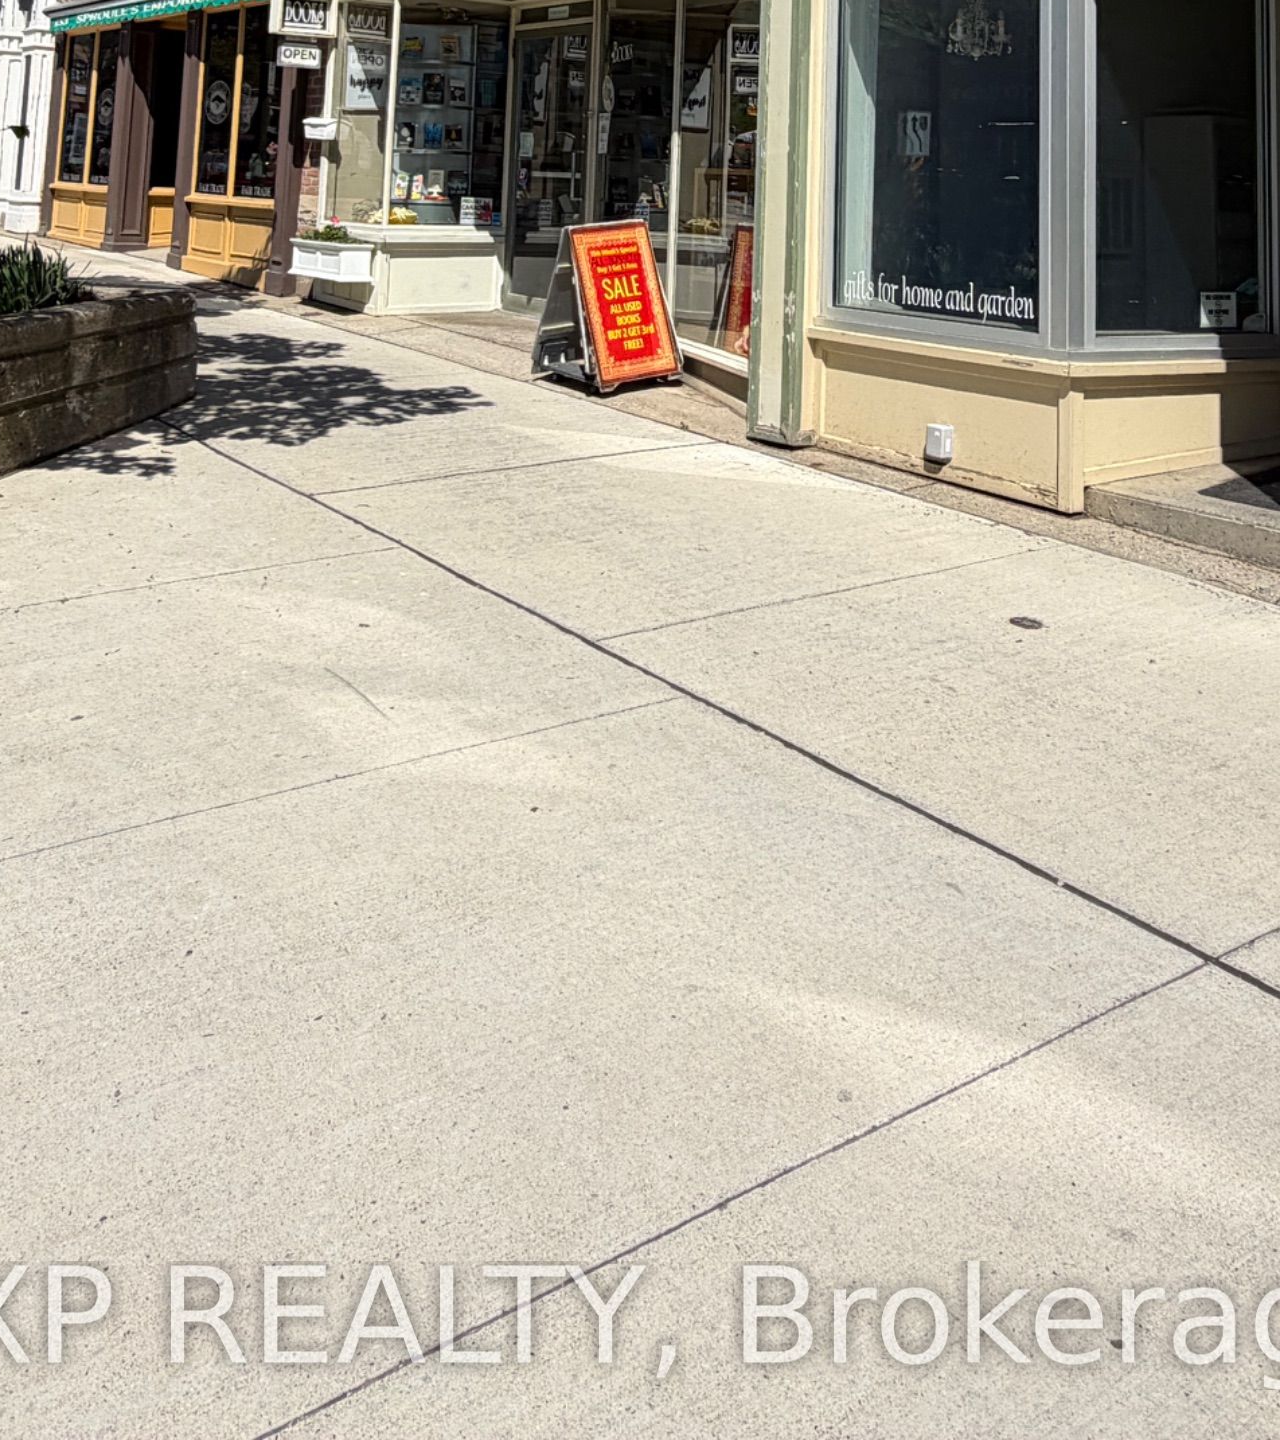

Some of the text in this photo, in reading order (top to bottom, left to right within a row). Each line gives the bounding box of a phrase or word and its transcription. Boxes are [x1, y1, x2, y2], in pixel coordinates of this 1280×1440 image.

[283, 48, 317, 61] OPEN
[602, 274, 642, 300] SALE
[843, 271, 1036, 323] gifts for home and garden
[610, 301, 642, 315] ALL USED
[616, 313, 641, 326] BOOKS
[607, 329, 622, 340] BUY
[628, 326, 641, 337] GET
